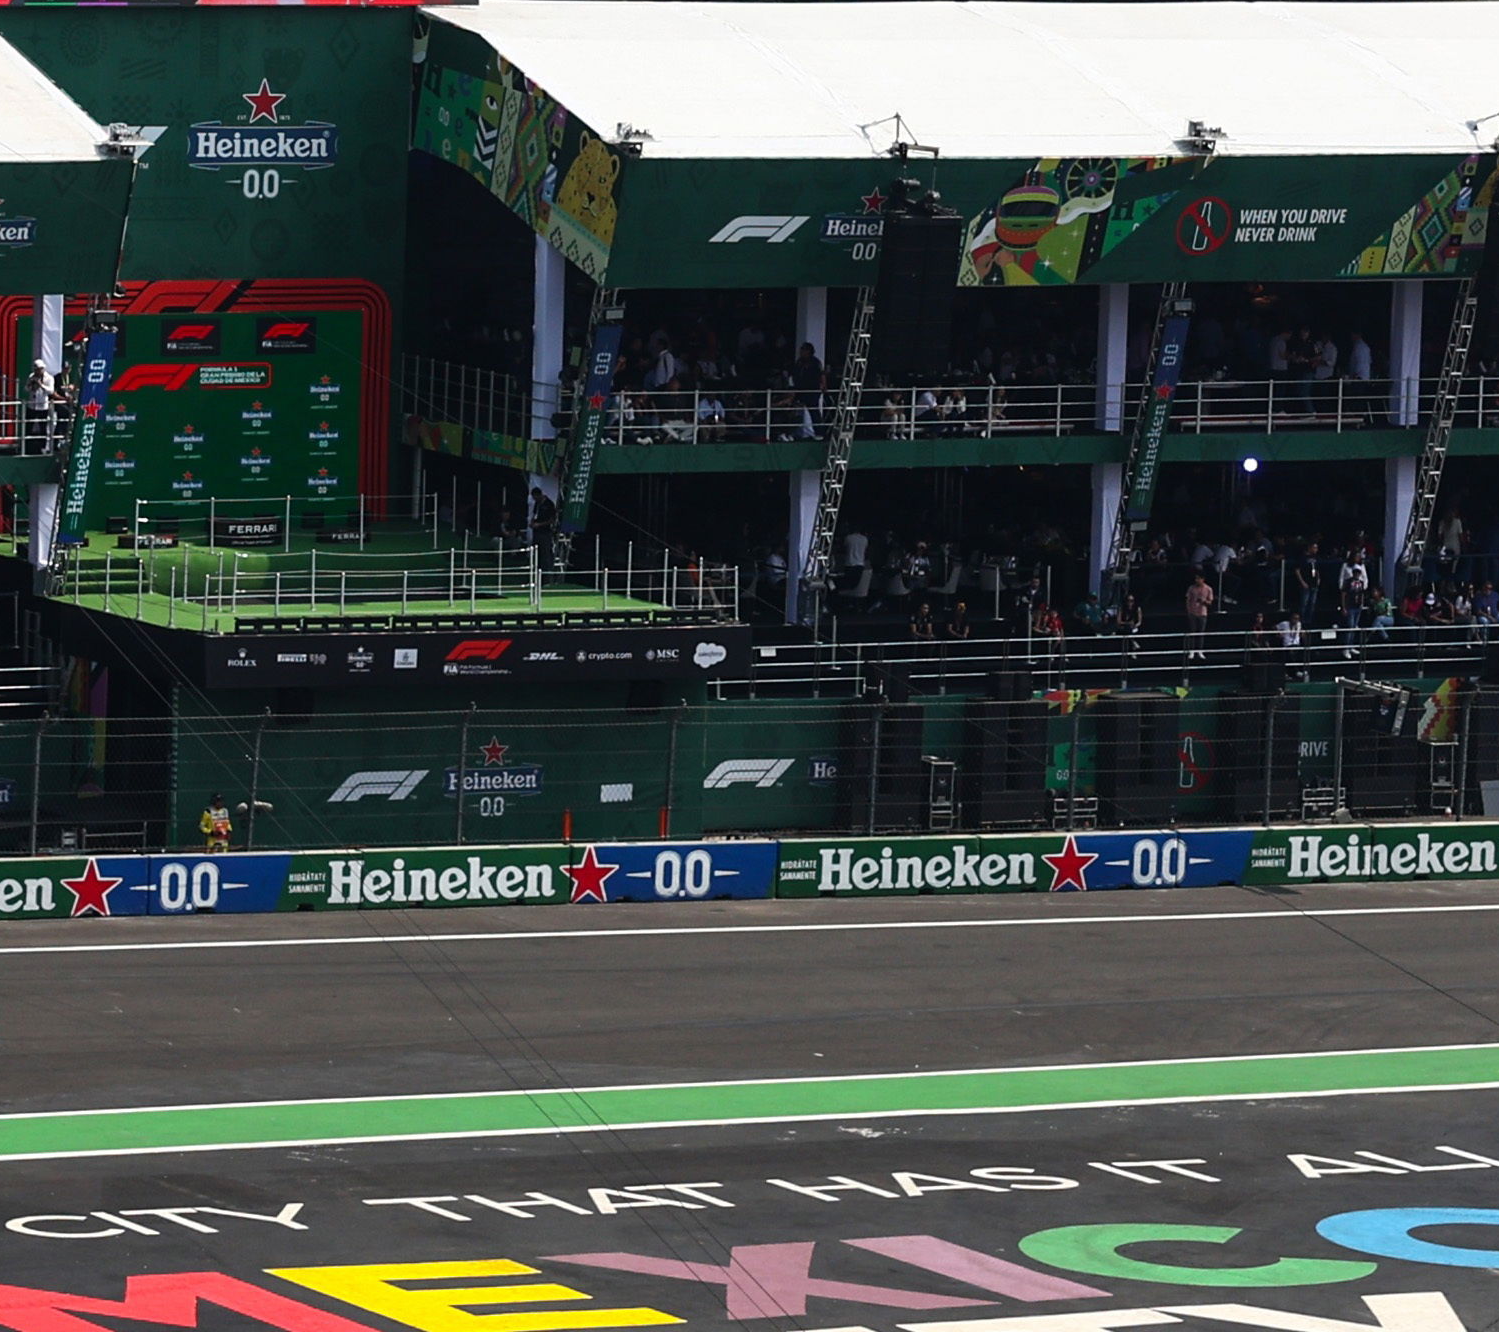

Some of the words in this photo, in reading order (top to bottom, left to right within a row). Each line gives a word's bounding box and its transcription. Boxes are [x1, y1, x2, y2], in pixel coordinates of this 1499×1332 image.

[196, 132, 328, 157] Heineken
[243, 170, 279, 198] 0.0
[1241, 210, 1277, 224] WHEN
[1282, 210, 1307, 223] YOU
[1310, 209, 1347, 223] DRIVE
[1235, 228, 1274, 242] NEVER
[1278, 227, 1317, 241] DRINK
[1136, 403, 1166, 490] Heineken
[66, 423, 96, 513] Heineken
[229, 523, 277, 535] FERRARI
[228, 658, 257, 667] ROLEX
[588, 650, 633, 663] crypto.com
[656, 648, 680, 660] MSC
[481, 797, 504, 816] 0.0
[655, 850, 711, 896] 0.0
[818, 846, 1036, 890] Heineken
[1133, 839, 1186, 884] 0.0
[1288, 834, 1497, 877] Heineken
[161, 862, 218, 910] 0.0
[328, 857, 555, 903] Heineken
[5, 1203, 308, 1239] CITY
[363, 1181, 735, 1222] THAT
[767, 1167, 1079, 1202] HAS
[1088, 1158, 1222, 1184] IT
